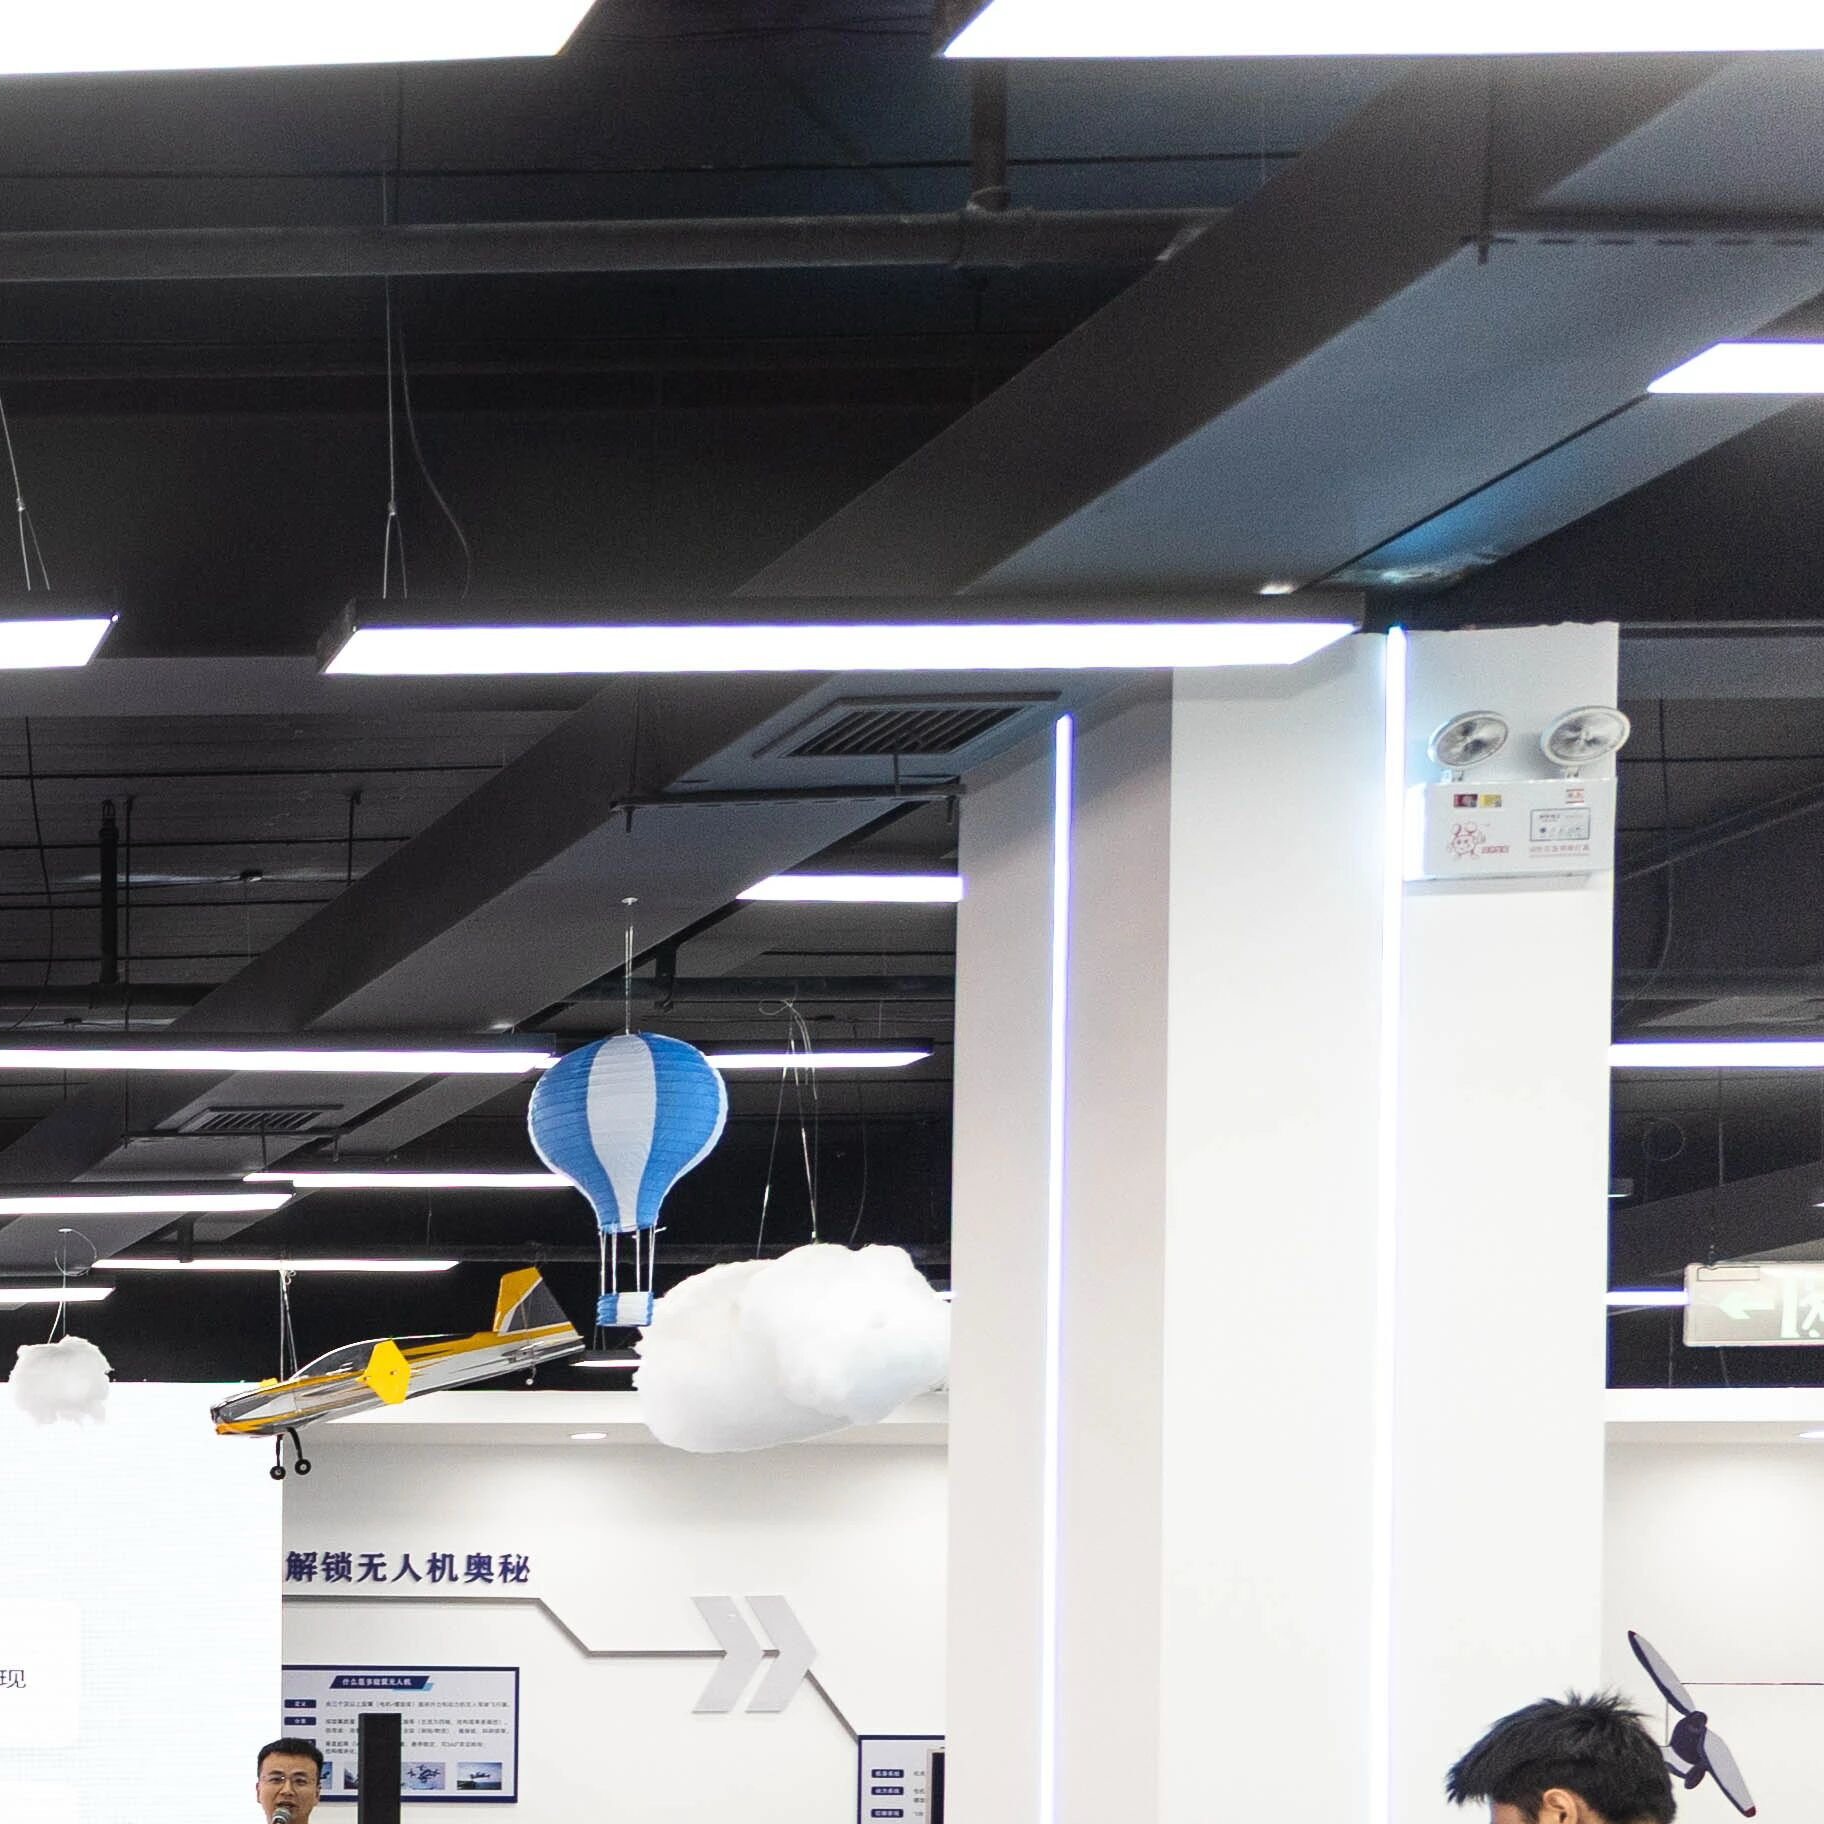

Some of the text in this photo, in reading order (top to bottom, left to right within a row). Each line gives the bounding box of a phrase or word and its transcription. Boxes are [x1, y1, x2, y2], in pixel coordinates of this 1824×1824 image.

[285, 1550, 531, 1585] 解锁无人机奥秘
